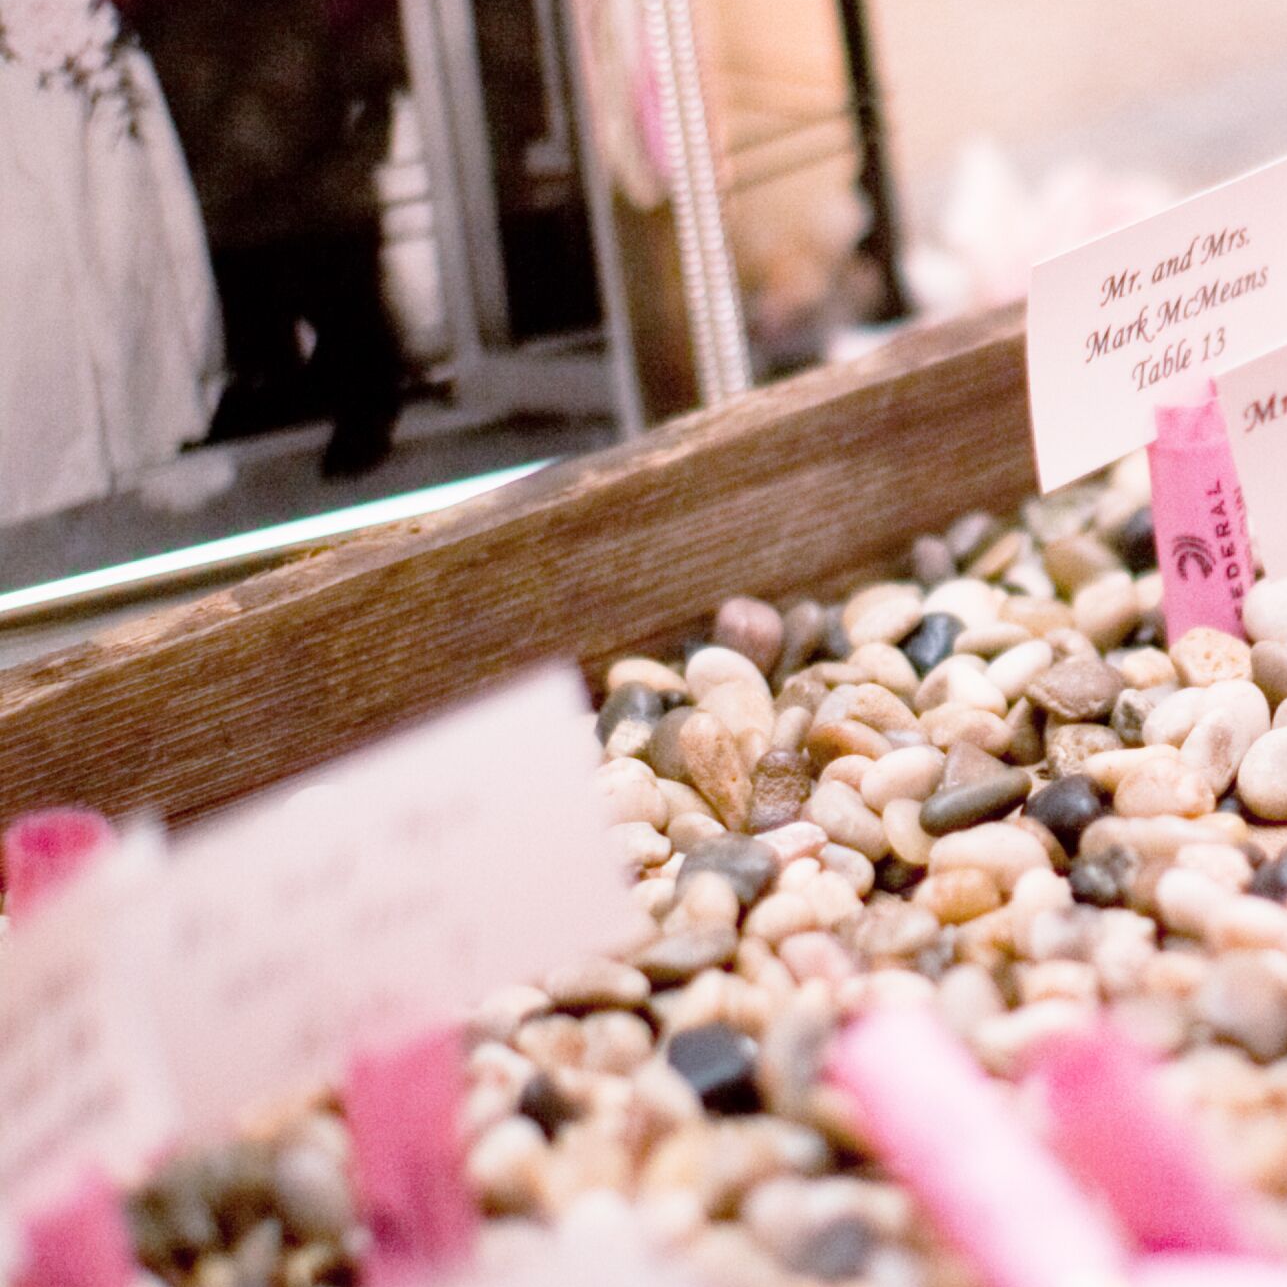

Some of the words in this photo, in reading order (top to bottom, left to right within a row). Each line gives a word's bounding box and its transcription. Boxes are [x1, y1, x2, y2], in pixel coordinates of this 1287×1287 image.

[1100, 268, 1142, 308] Mr.
[1151, 234, 1200, 285] and
[1200, 227, 1251, 265] Mrs.
[1085, 304, 1156, 364] Mark
[1156, 265, 1270, 333] McMeans
[1131, 337, 1193, 392] Table
[1200, 325, 1226, 363] 13
